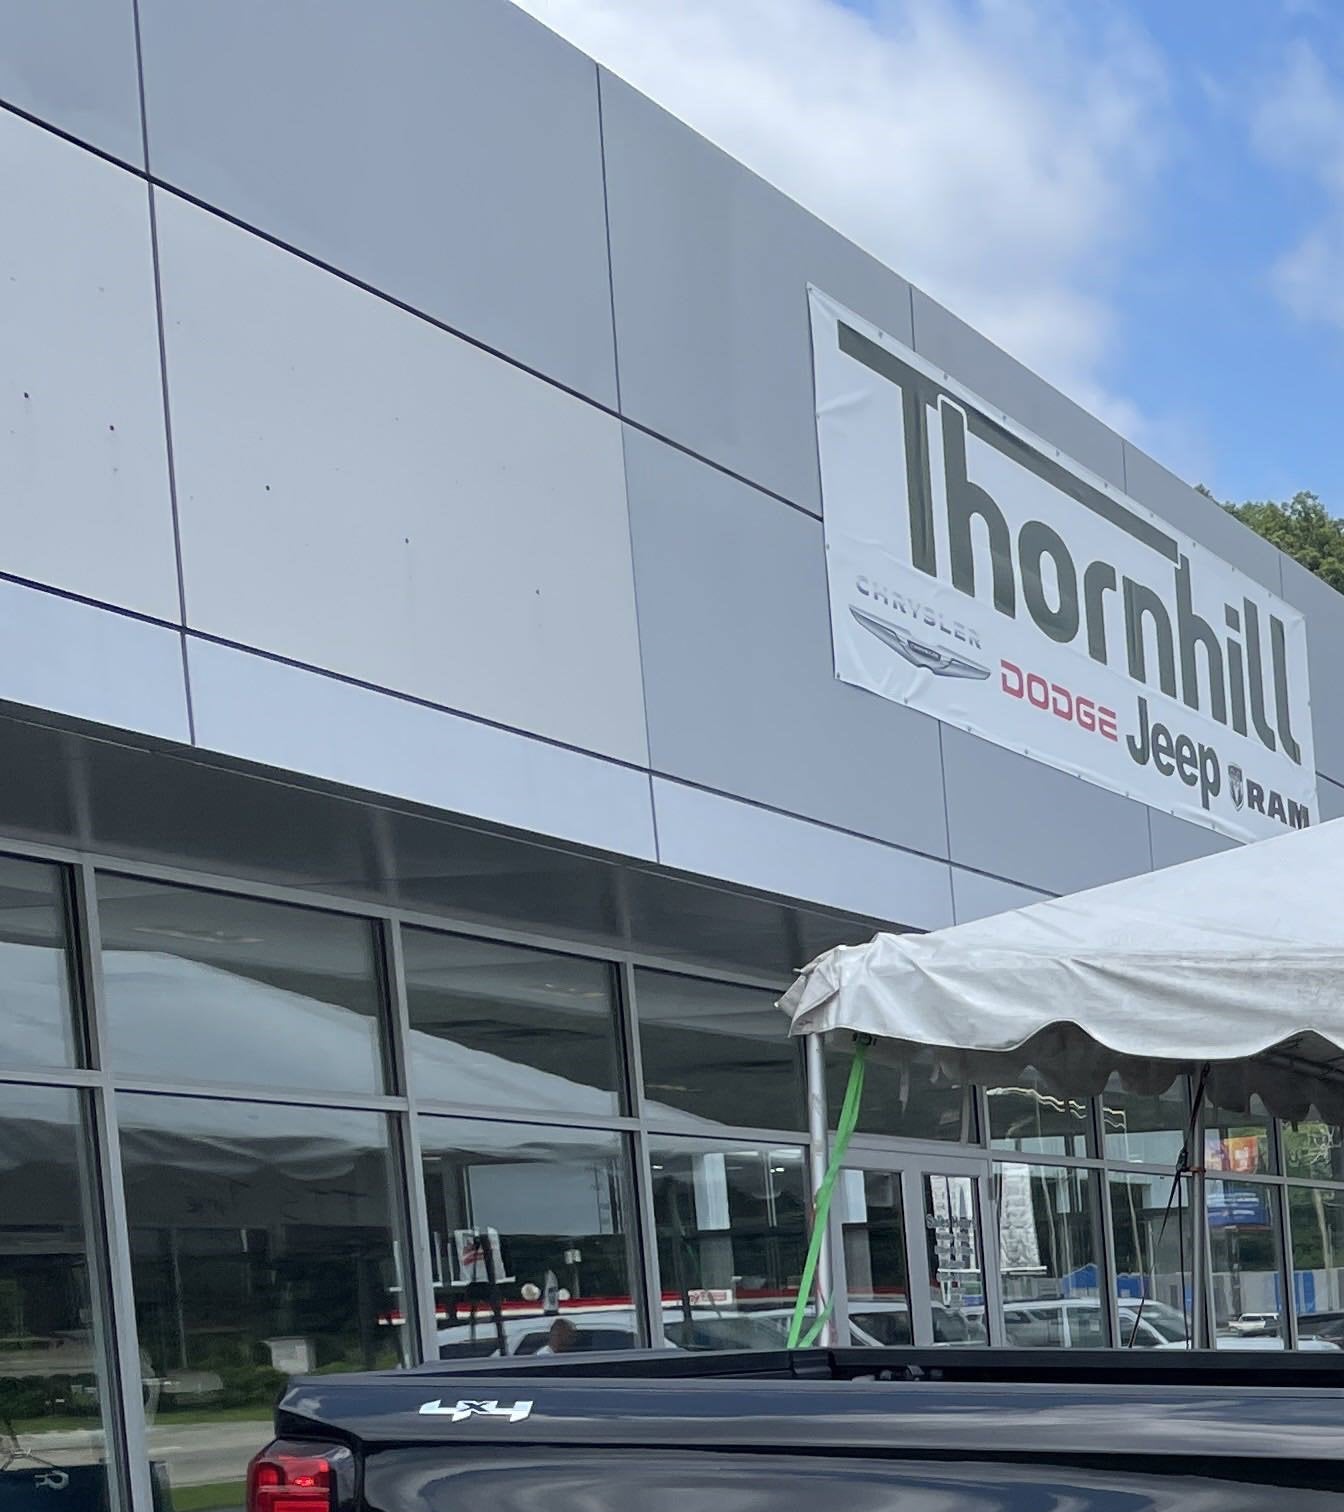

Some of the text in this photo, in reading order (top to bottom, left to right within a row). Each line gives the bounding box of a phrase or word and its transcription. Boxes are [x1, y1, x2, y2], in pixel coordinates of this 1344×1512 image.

[838, 319, 1302, 766] Thornhill
[856, 575, 982, 650] CHRYSLER
[1000, 659, 1118, 742] DODGE
[1126, 696, 1222, 810] Jeep
[1246, 779, 1310, 830] RAM
